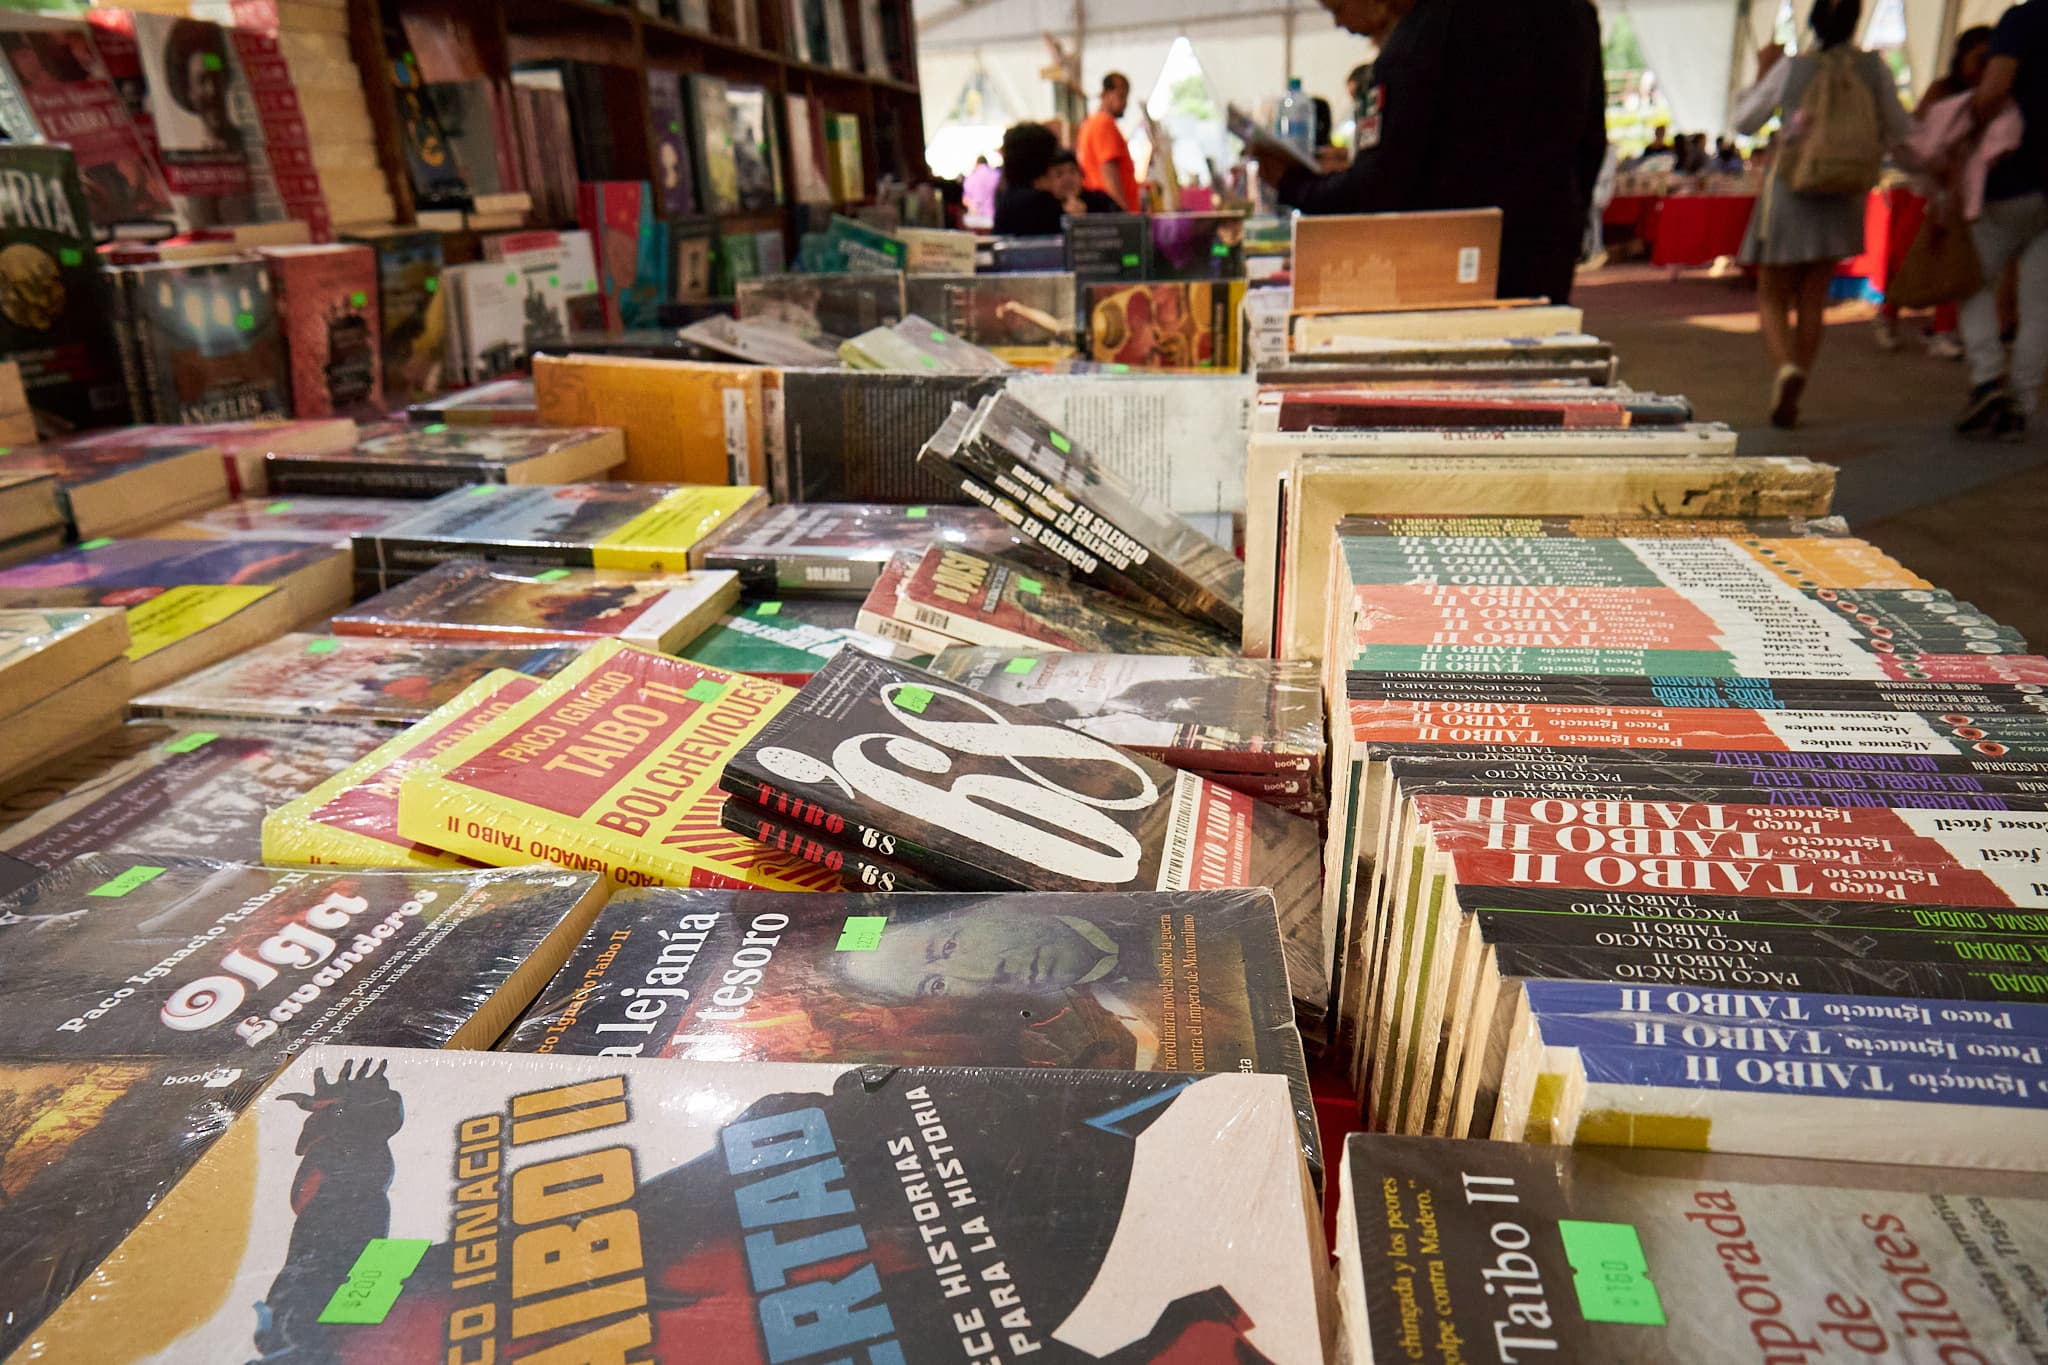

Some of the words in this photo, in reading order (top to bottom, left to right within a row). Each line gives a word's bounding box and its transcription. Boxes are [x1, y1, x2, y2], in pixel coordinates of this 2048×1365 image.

[1055, 513, 1076, 535] EN
[1073, 504, 1094, 527] EN
[1090, 516, 1149, 565] SILENCIO
[1021, 517, 1043, 539] EN
[1038, 528, 1098, 574] SILENCIO
[1450, 645, 1525, 656] TAIBO
[1446, 662, 1523, 672] TAIBO
[1651, 686, 1719, 699] MADRID
[498, 725, 567, 763] PACO
[558, 671, 634, 728] IGNACIO
[1441, 701, 1531, 715] TAIBO
[1442, 713, 1535, 728] TAIBO
[1549, 717, 1618, 730] Ignacio
[1624, 721, 1670, 731] Paco
[1785, 723, 1839, 733] nubes
[1841, 725, 1912, 736] Algunas
[542, 704, 668, 778] TAIBO
[1417, 727, 1438, 741] II
[1450, 728, 1544, 744] TAIBO
[1559, 732, 1629, 746] Ignacio
[1636, 735, 1683, 747] Paco
[1801, 738, 1856, 749] nubes
[1859, 740, 1932, 752] Algunas
[596, 681, 782, 837] BOLCHEVIQUES
[1531, 763, 1588, 773] TAIBO
[1711, 750, 1765, 767] FELIZ
[1772, 752, 1827, 769] FINAL
[1908, 755, 1940, 772] NO
[1485, 769, 1567, 782] IGNACIO
[1572, 771, 1622, 783] PACO
[1750, 770, 1801, 787] FELIZ
[1808, 771, 1870, 789] FINAL
[1951, 774, 1985, 793] NO
[1211, 784, 1232, 800] II
[758, 782, 844, 834] TAIBO
[1206, 799, 1231, 841] TAIBO
[1464, 797, 1508, 823] II
[1530, 798, 1738, 831] TAIBO
[1747, 807, 1853, 824] Ignacio
[448, 816, 460, 833] II
[1483, 823, 1534, 850] II
[1753, 819, 1821, 835] Paco
[1934, 817, 1993, 832] fácil
[467, 822, 523, 853] TAIBO
[757, 820, 844, 872] TAIBO
[1173, 831, 1187, 848] THE
[1556, 826, 1774, 860] TAIBO
[1781, 835, 1893, 853] Ignacio
[530, 841, 609, 876] IGNACIO
[1173, 844, 1185, 859] OF
[1789, 848, 1861, 865] Paco
[1980, 847, 2042, 864] fácil
[1508, 852, 1561, 884] II
[1584, 856, 1814, 895] TAIBO
[1822, 867, 1941, 888] Ignacio
[1627, 893, 1697, 908] TAIBO
[1830, 881, 1907, 900] Paco
[1571, 903, 1668, 918] IGNACIO
[1676, 907, 1741, 922] PACO
[1160, 914, 1176, 941] guerra
[1655, 922, 1728, 938] TAIBO
[56, 987, 136, 1033] Paco
[125, 926, 226, 985] Ignacio
[216, 880, 288, 924] Taibo
[281, 872, 310, 888] II
[1159, 940, 1172, 950] la
[1181, 914, 1200, 970] Maximiliano
[1595, 932, 1700, 950] IGNACIO
[1707, 938, 1774, 954] PACO
[160, 892, 368, 1032] Olga
[596, 911, 720, 1035] lejanía
[695, 913, 790, 1024] tesoro
[1158, 951, 1174, 978] sobre
[1616, 964, 1725, 982] IGNACIO
[1676, 954, 1753, 970] TAIBO
[305, 995, 354, 1036] novelas
[404, 930, 430, 952] una
[309, 1033, 333, 1048] la
[328, 982, 391, 1034] periodista
[385, 961, 413, 984] más
[408, 917, 462, 966] indomable
[547, 980, 597, 1034] Ignacio
[584, 941, 622, 978] Taibo
[611, 928, 632, 943] II
[1184, 971, 1200, 983] de
[1731, 969, 1801, 986] PACO
[1158, 977, 1176, 1010] novela
[1184, 984, 1205, 1022] imperio
[1620, 988, 1652, 1012] II
[1666, 991, 1810, 1021] TAIBO
[1824, 1004, 1932, 1025] Ignacio
[1186, 1022, 1203, 1036] el
[1942, 1009, 2014, 1029] Paco
[1160, 1011, 1178, 1072] raordinaria
[1633, 1022, 1667, 1046] II
[1681, 1024, 1831, 1055] TAIBO
[1192, 1038, 1205, 1072] contra
[1844, 1036, 1959, 1060] Ignacio
[1967, 1044, 2043, 1065] Paco
[1685, 1055, 1721, 1082] II
[1735, 1056, 1894, 1092] TAIBO
[1908, 1073, 2030, 1098] Ignacio
[512, 1075, 629, 1146] II
[905, 1085, 977, 1208] HISTORIA
[1460, 1171, 1520, 1206] II
[451, 1114, 502, 1291] IGNACIO
[1382, 1176, 1410, 1231] peores
[887, 1135, 972, 1299] HISTORIAS
[721, 1106, 897, 1365] RTAD
[961, 1215, 997, 1254] LA
[1387, 1232, 1407, 1258] los
[512, 1147, 655, 1365] AIBO
[1395, 1260, 1417, 1273] y
[1427, 1260, 1454, 1317] contra
[1481, 1221, 1559, 1365] Taibo
[981, 1261, 1042, 1356] PARA
[1391, 1273, 1425, 1360] chingada
[448, 1303, 497, 1365] CO
[1817, 1292, 1890, 1356] de
